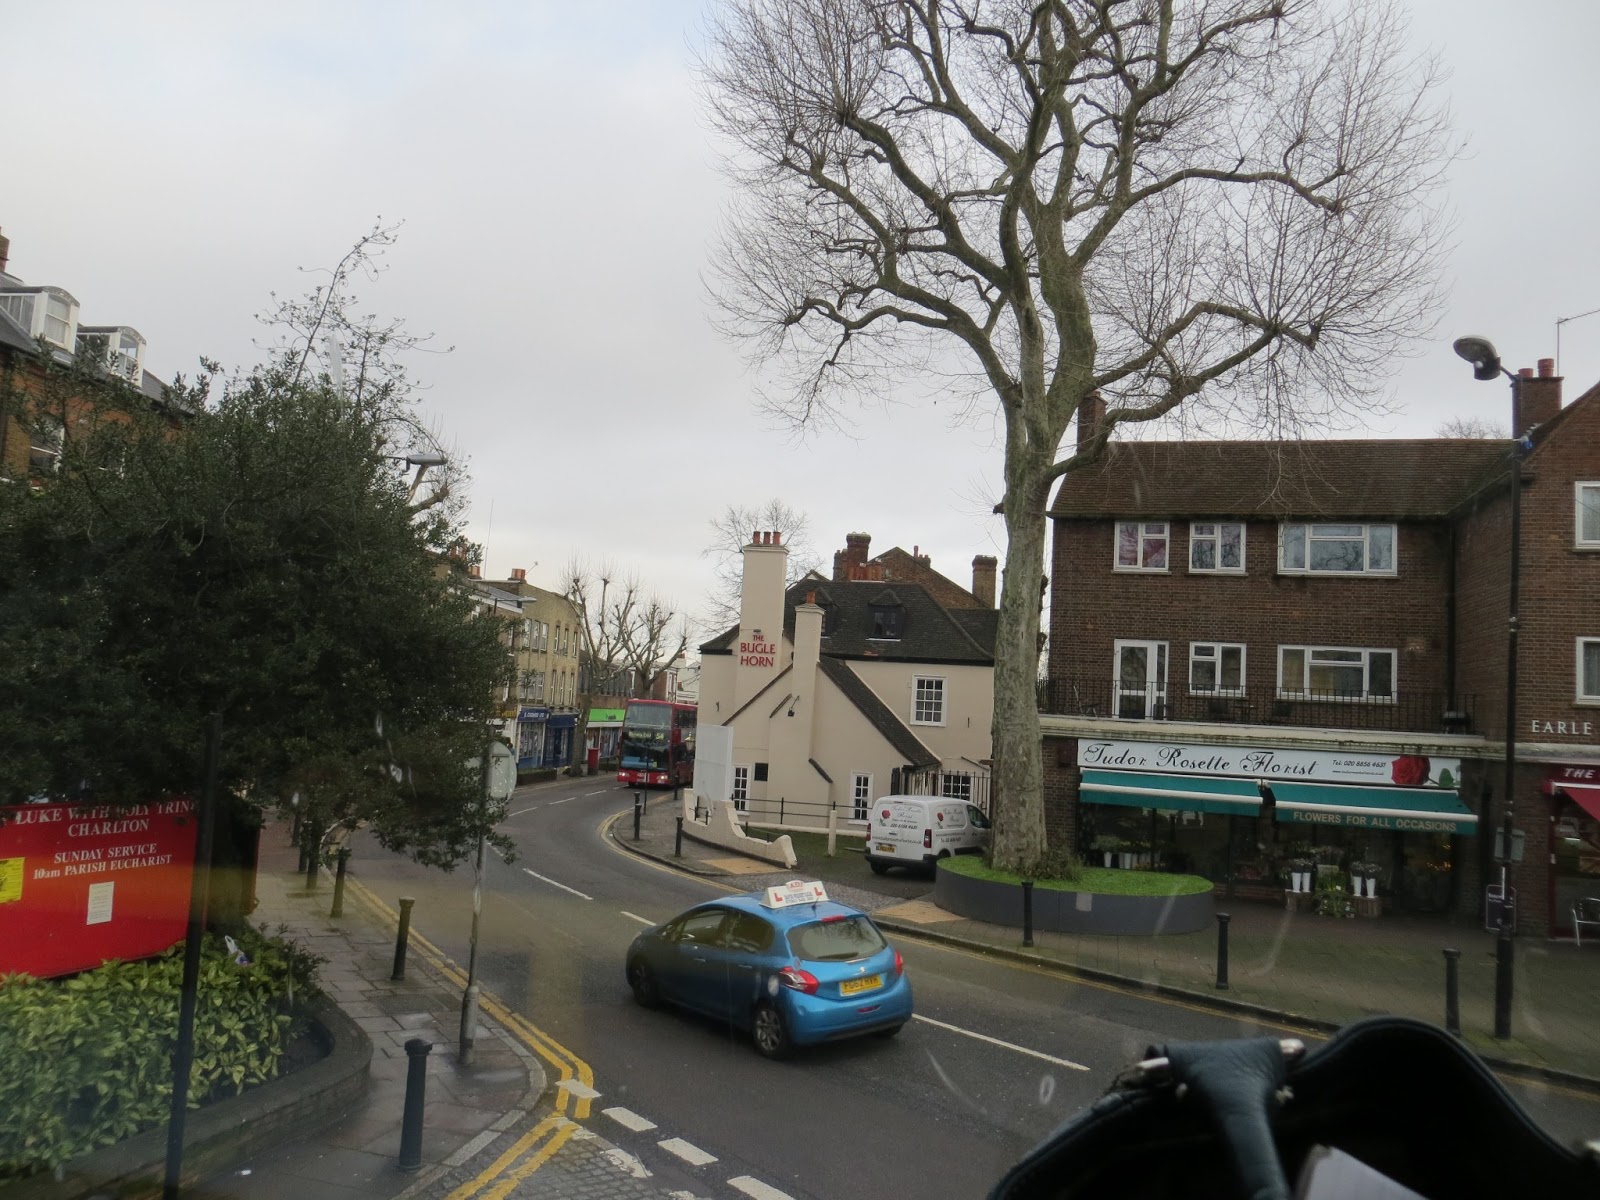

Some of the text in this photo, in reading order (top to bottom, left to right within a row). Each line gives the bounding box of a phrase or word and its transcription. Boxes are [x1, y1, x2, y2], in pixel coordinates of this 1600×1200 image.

[740, 642, 776, 654] BUGLE
[740, 655, 774, 667] HORN
[1531, 719, 1592, 735] EARLE
[1083, 743, 1320, 775] Tudor Rosette Florist
[1564, 768, 1595, 779] THE
[16, 808, 62, 824] LUKE
[1293, 811, 1457, 832] FLOWERS FOR ALL OCCASIONS
[68, 818, 150, 837] CHARLTON
[54, 843, 157, 864] SUNDAY SERVICE
[33, 854, 173, 880] 10am PARISH EUCHARIST
[773, 892, 783, 902] L
[814, 886, 823, 896] L
